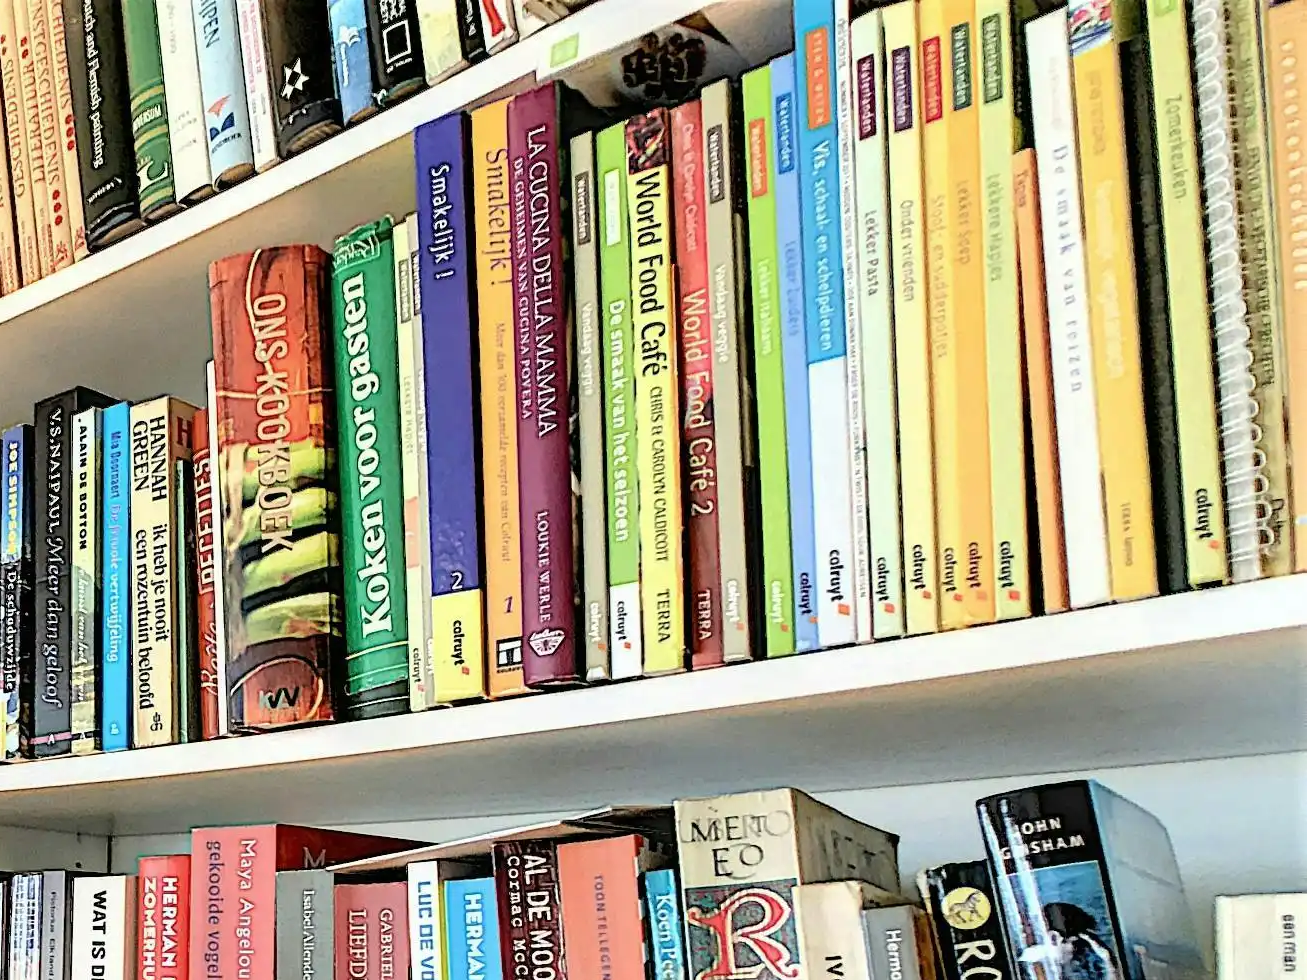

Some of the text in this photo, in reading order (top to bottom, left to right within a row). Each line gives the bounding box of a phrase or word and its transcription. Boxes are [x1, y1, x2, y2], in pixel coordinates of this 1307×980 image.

[3, 59, 25, 198] GESCHIEDENIS
[22, 60, 45, 184] LITERATUUR
[1164, 94, 1188, 200] Zomerkeuken
[429, 163, 455, 280] Smakelijk !
[524, 125, 558, 438] LA CUCINA DELLA MAMMA
[635, 171, 668, 377] World Food Café
[681, 287, 711, 371] World
[253, 293, 294, 553] ONS KOOKBOEK
[608, 300, 630, 543] De smaak van het seizoen
[684, 370, 713, 429] Food
[132, 420, 150, 492] GREEN
[148, 415, 167, 501] HANNAH
[342, 270, 393, 639] Koken voor gasten
[688, 438, 714, 495] Café
[78, 425, 88, 550] ALAIN DE BOTTON
[691, 499, 715, 516] 2
[45, 536, 65, 582] Meer
[451, 572, 463, 589] 2
[536, 510, 552, 623] LOUKIE WERLE
[828, 549, 844, 602] colruyt
[876, 557, 890, 602] colruyt
[912, 544, 925, 589] colruyt
[944, 547, 957, 592] colruyt
[43, 587, 63, 630] dan
[136, 530, 155, 710] een rozentuin beloofd
[656, 588, 672, 644] TERRA
[697, 589, 712, 641] TERRA
[452, 620, 464, 666] colruyt
[41, 640, 63, 709] geloof
[207, 839, 226, 924] gekooide
[239, 838, 256, 892] Maya
[523, 854, 543, 888] AL
[90, 890, 107, 934] WAT
[161, 876, 178, 967] HERMAN
[417, 880, 433, 920] LUC
[526, 892, 551, 922] DE
[90, 941, 106, 959] IS
[235, 896, 256, 980] Angelou
[419, 928, 434, 950] DE
